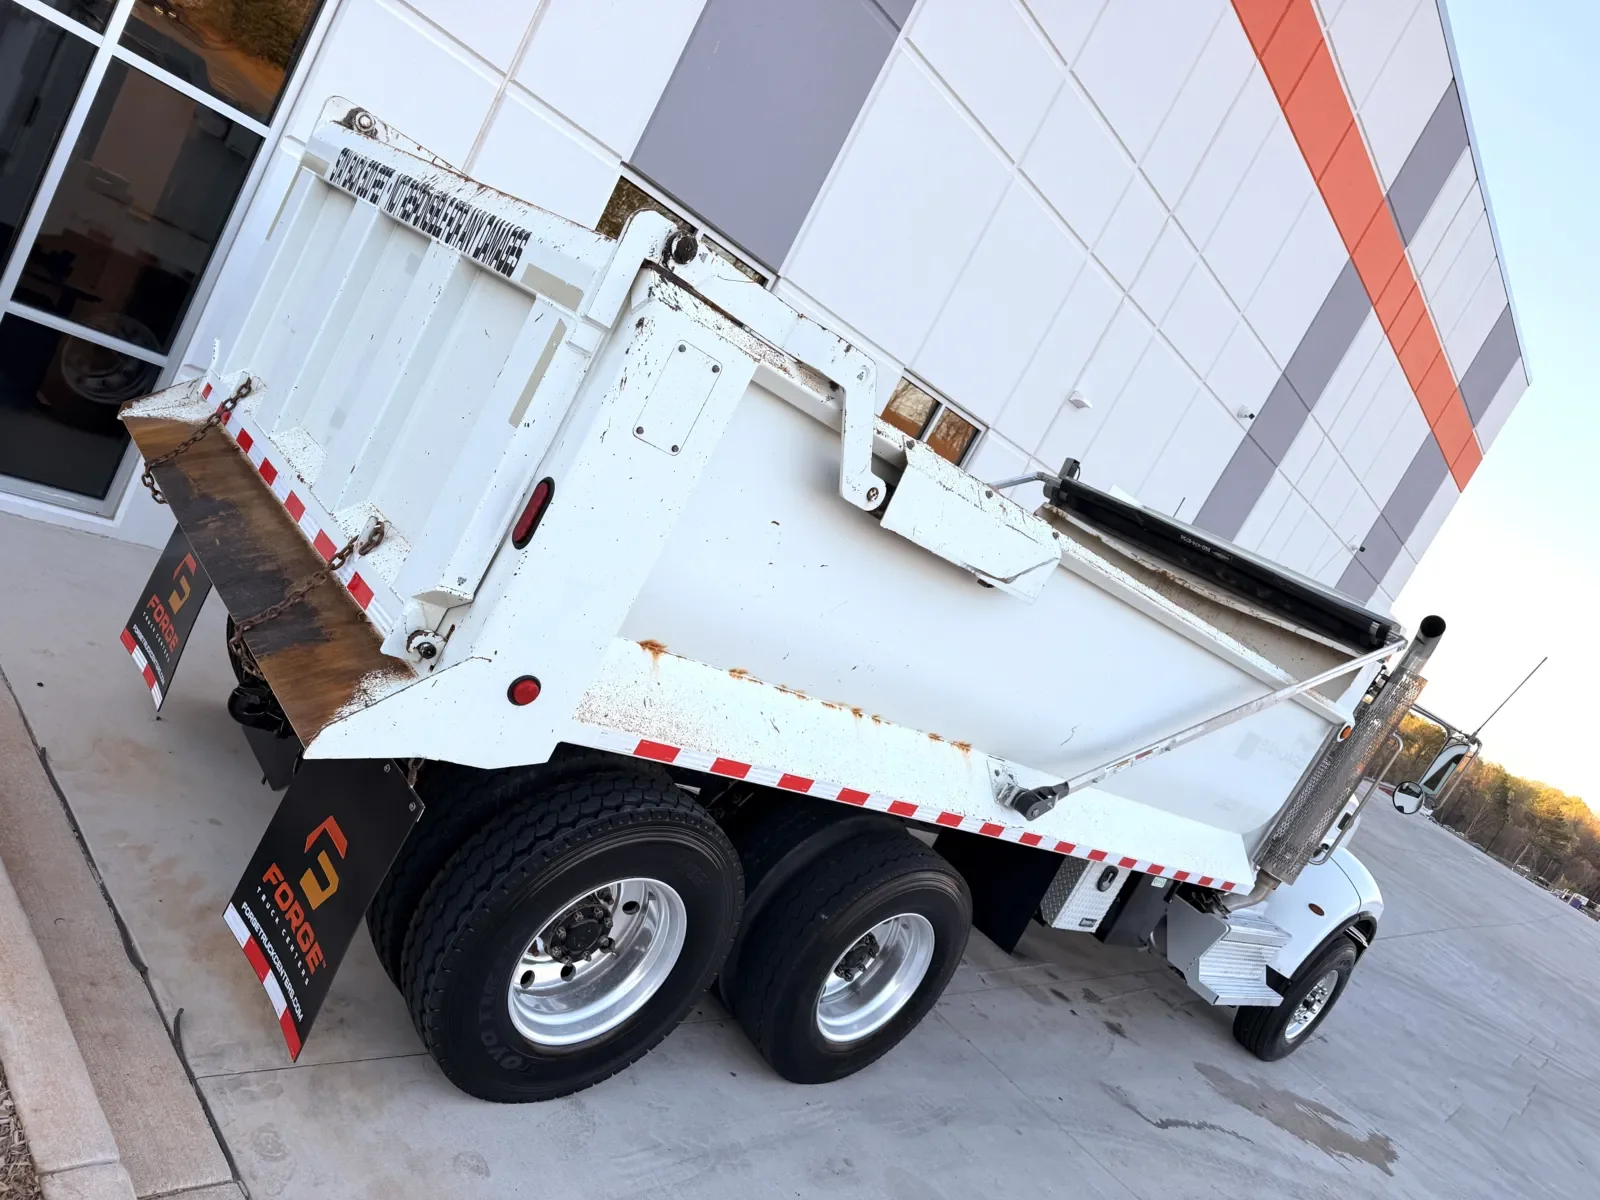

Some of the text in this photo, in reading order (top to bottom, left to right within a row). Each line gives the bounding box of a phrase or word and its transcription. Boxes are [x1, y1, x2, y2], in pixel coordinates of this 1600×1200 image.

[366, 164, 396, 206] FEET
[455, 206, 490, 256] ANY
[472, 214, 532, 278] DAMAGES
[147, 594, 179, 653] FORGE
[256, 886, 309, 986] TRUCK CENTERS
[262, 863, 324, 975] FORGE
[241, 901, 304, 1022] FORGETRUCKCENTERS.COM
